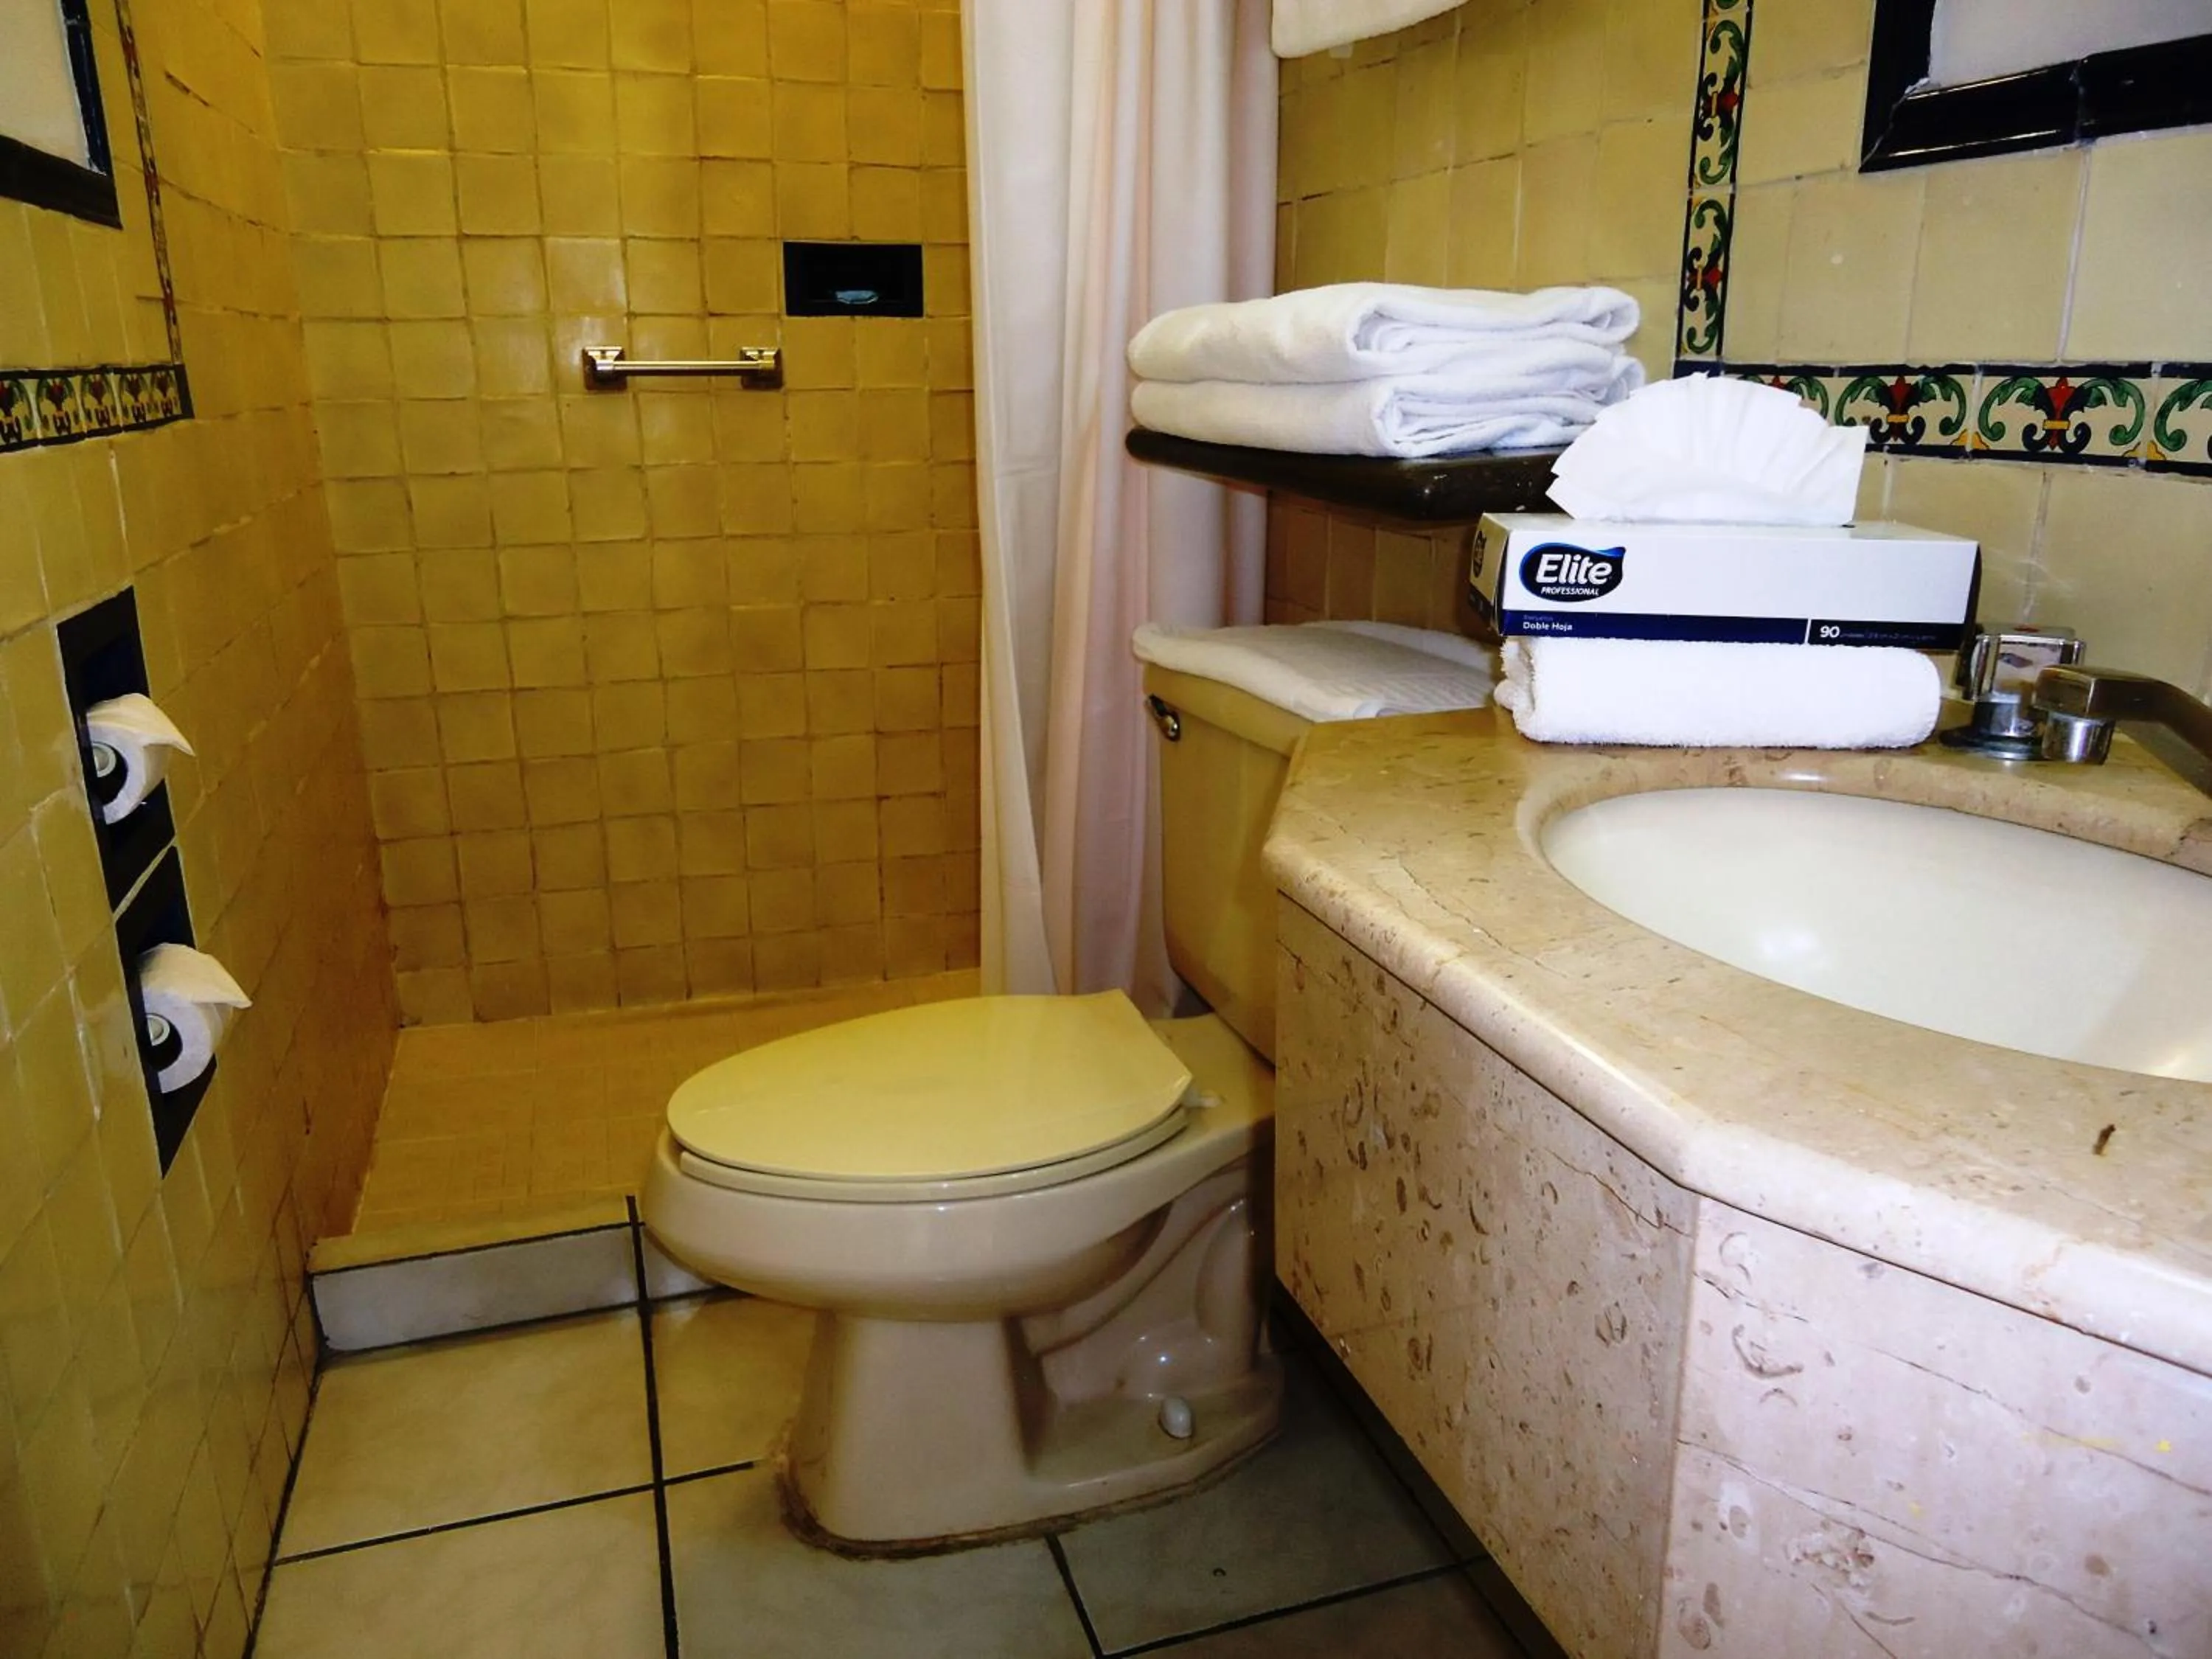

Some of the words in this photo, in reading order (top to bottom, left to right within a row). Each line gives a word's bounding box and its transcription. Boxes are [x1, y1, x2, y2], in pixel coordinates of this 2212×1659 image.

[1536, 554, 1613, 585] Elite
[1541, 586, 1599, 596] PROFESSIONAL
[1523, 622, 1550, 630] Doble
[1552, 622, 1573, 632] Hoja
[1820, 625, 1840, 638] 90
